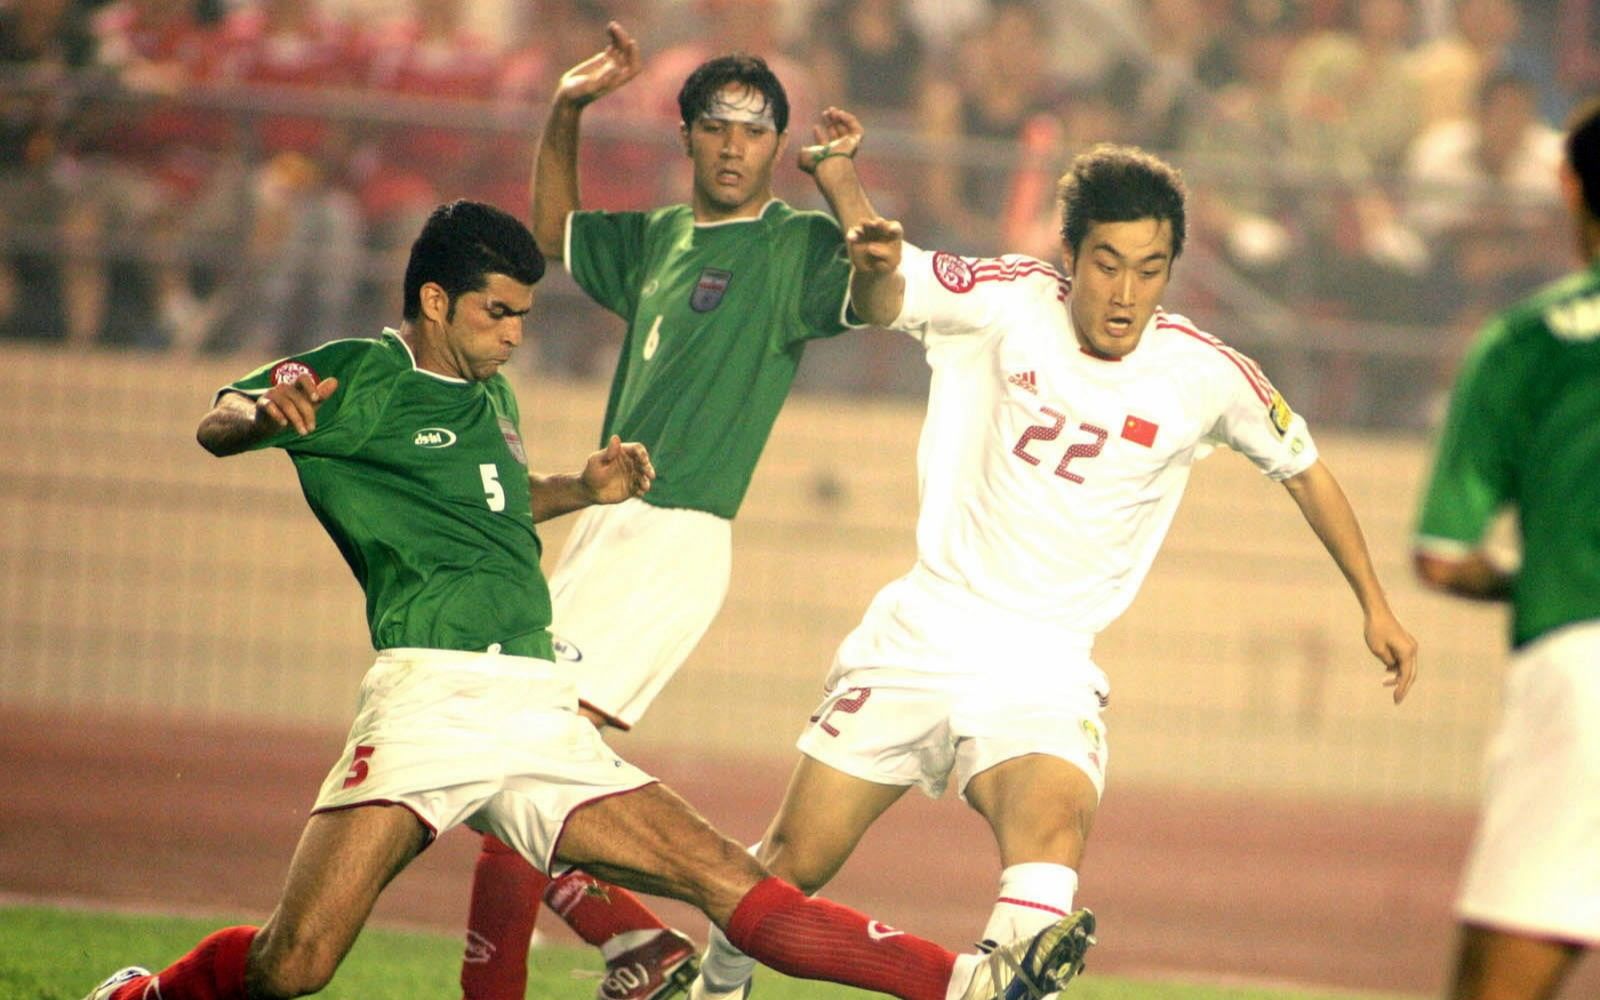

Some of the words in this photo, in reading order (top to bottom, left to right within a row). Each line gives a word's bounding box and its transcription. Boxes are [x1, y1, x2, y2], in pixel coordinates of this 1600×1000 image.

[643, 315, 664, 361] 6
[1012, 406, 1108, 485] 22
[479, 463, 506, 512] 5
[342, 745, 375, 789] 5
